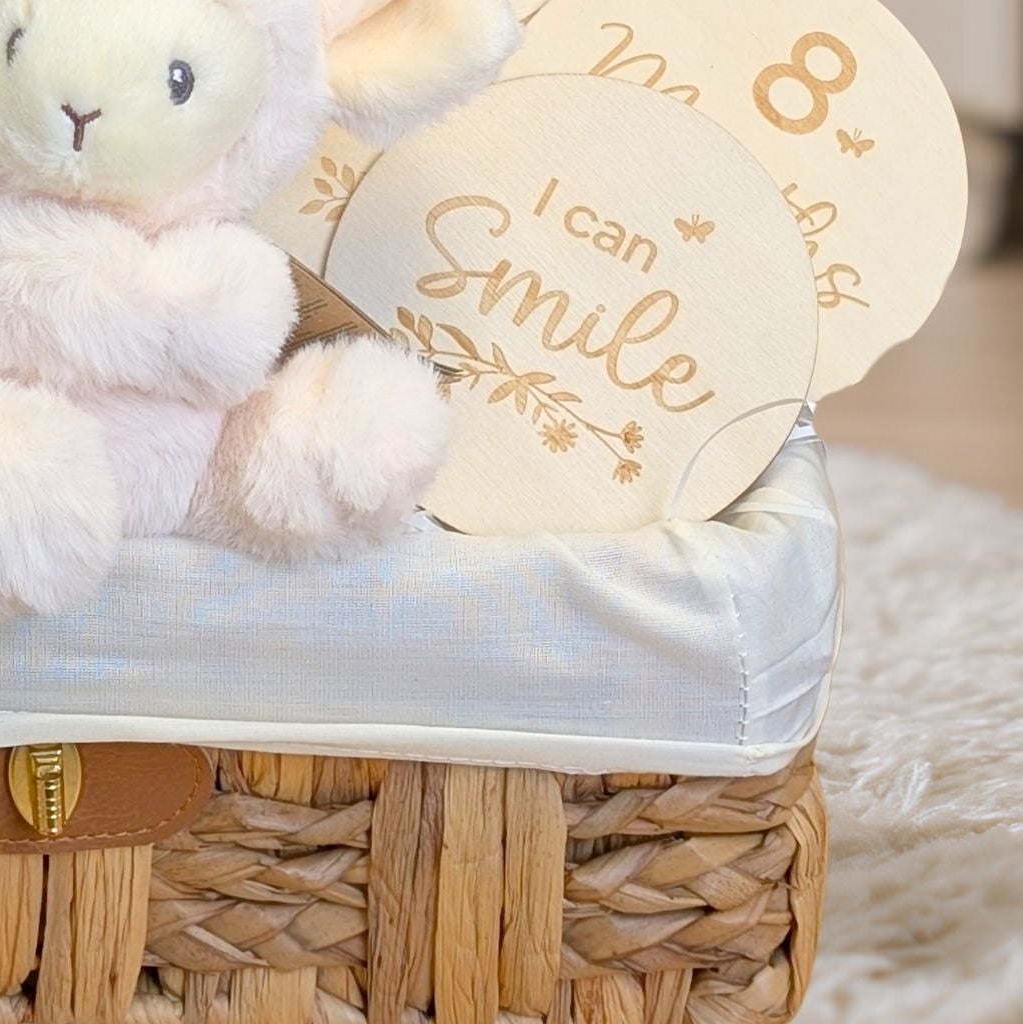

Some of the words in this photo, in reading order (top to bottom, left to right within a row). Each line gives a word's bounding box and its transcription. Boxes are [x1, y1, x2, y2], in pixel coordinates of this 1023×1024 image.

[752, 31, 857, 135] 8
[533, 177, 559, 217] I
[563, 205, 659, 274] can
[416, 194, 715, 413] Smile
